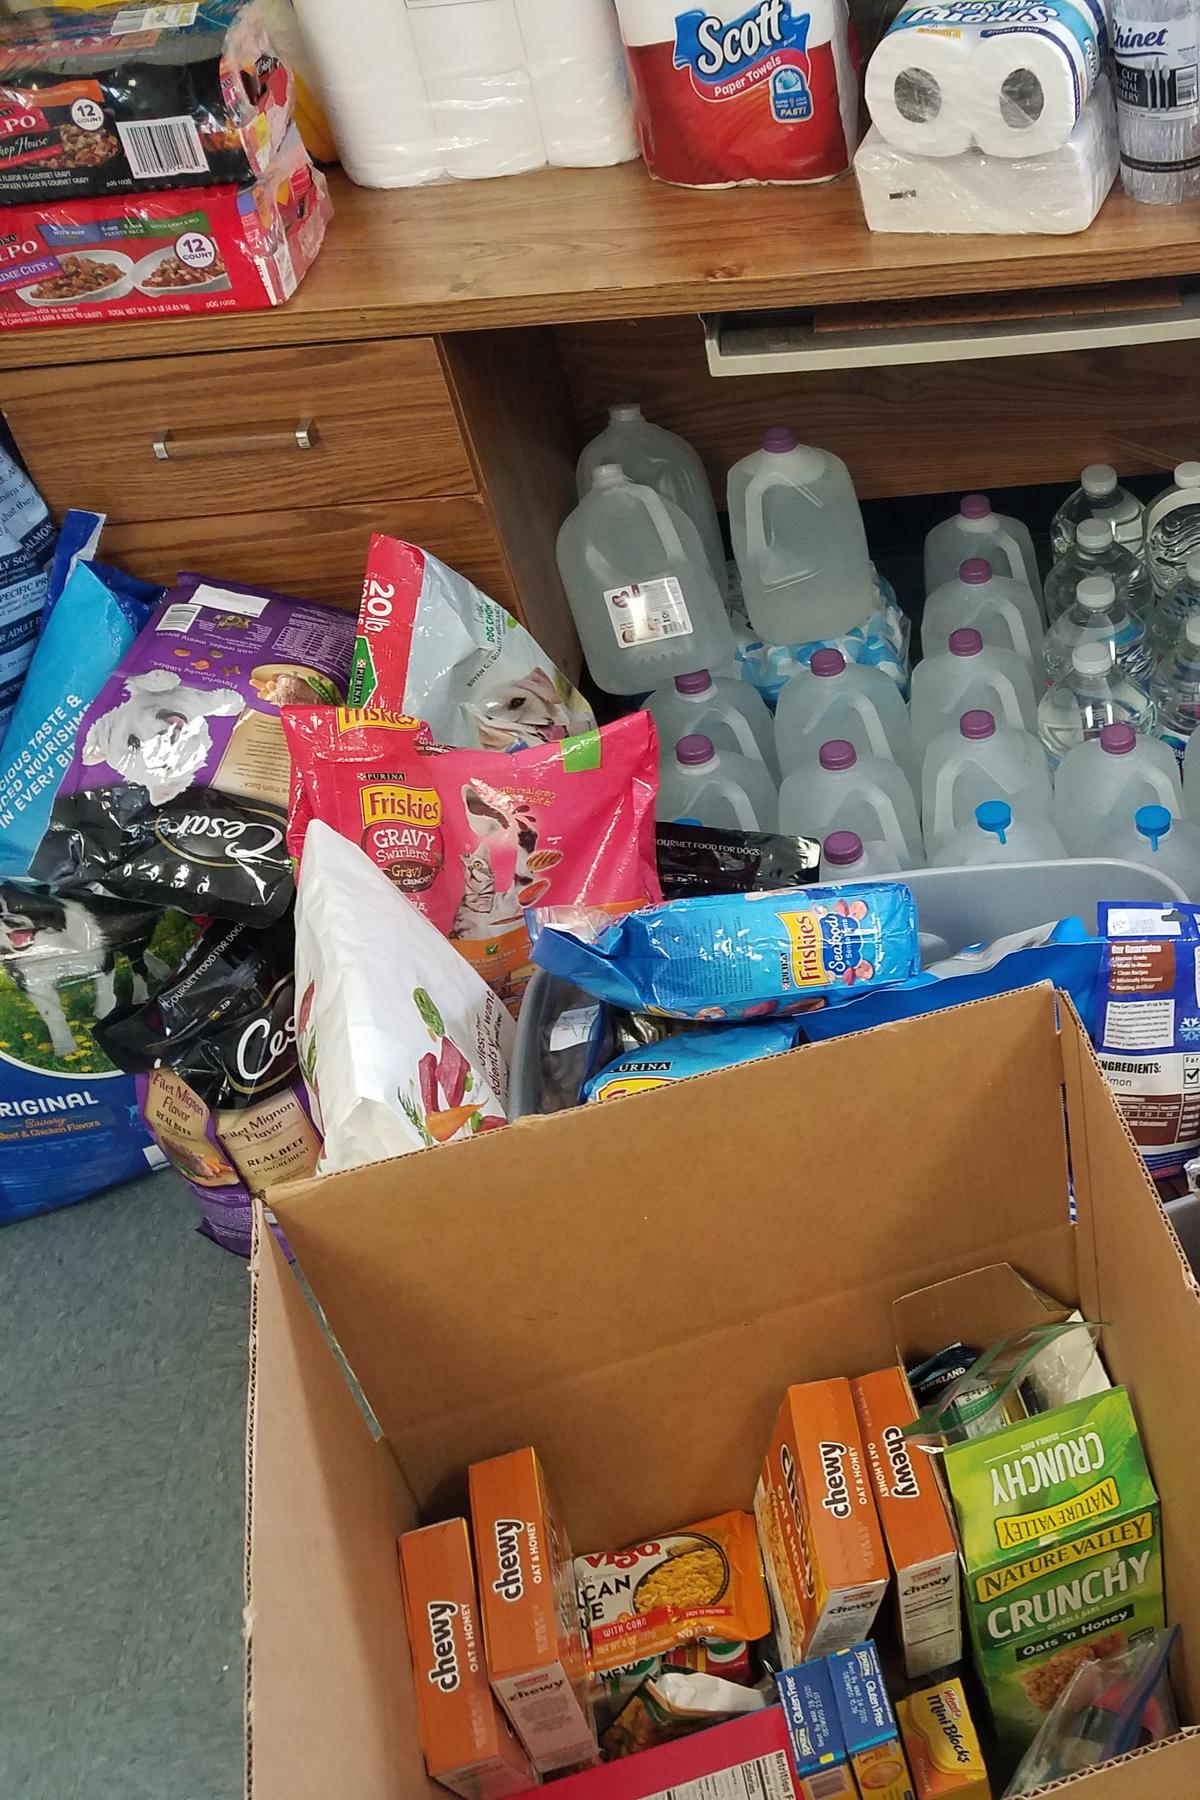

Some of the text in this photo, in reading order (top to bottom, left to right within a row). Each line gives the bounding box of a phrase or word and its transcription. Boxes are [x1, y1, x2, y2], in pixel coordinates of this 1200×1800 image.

[698, 0, 783, 73] Scott
[714, 55, 782, 97] Paper Towels
[1121, 68, 1139, 79] CUT
[0, 115, 36, 132] PO
[77, 104, 96, 117] 12
[77, 116, 102, 124] COUNT
[780, 107, 807, 117] FAST!
[15, 136, 48, 152] House
[0, 240, 38, 262] LPO
[182, 251, 213, 261] COUNT
[184, 239, 205, 252] 12
[20, 263, 48, 276] CUTS
[206, 299, 236, 309] DOG FOOD
[24, 521, 54, 552] ALMON
[0, 583, 33, 601] PECIFIC
[7, 618, 35, 639] ADULT
[485, 603, 496, 643] DOG CHOW
[354, 668, 366, 704] PURINA
[466, 668, 486, 688] BRYAN
[0, 694, 83, 792] CIOUS TASTE &
[24, 701, 93, 780] NOURISHM
[367, 772, 405, 781] PURINA
[0, 809, 15, 829] IN
[14, 765, 55, 812] EVERY
[369, 790, 439, 820] Friskies
[170, 813, 285, 860] Cesar
[373, 829, 436, 851] GRAVY
[693, 842, 717, 851] FOOD
[718, 844, 736, 853] FOR
[737, 847, 761, 857] DOGS
[391, 864, 423, 878] Gravy
[796, 915, 821, 981] Friskies
[824, 913, 846, 972] Seafood
[167, 922, 247, 1008] GOURMET FOOD FOR DOGS
[236, 1016, 296, 1080] Ces
[619, 1063, 668, 1073] URINA
[1100, 1059, 1162, 1075] NGREDIENTS:
[0, 1090, 99, 1117] RIGINAL
[152, 1073, 204, 1117] Filet Mignon
[162, 1096, 191, 1122] Flavor
[220, 1127, 249, 1141] Filet
[249, 1100, 296, 1132] Mignon
[30, 1120, 101, 1137] Chicken Flavors
[155, 1110, 192, 1137] REAL BEEF
[245, 1119, 284, 1142] Flavor
[247, 1153, 276, 1168] REAL
[278, 1136, 305, 1156] BEEF
[264, 1147, 310, 1173] INGREDIENT
[919, 1366, 966, 1392] KIRKLAND
[848, 1446, 863, 1479] HONEY
[867, 1442, 890, 1499] OAT HONEY
[882, 1425, 920, 1500] chewy
[990, 1432, 1105, 1506] CRUNCHY
[819, 1441, 853, 1519] chewy
[856, 1486, 868, 1505] OAT
[1003, 1482, 1114, 1546] NATURE VALLEY
[526, 1520, 542, 1555] HONEY
[492, 1519, 524, 1603] chewy
[983, 1549, 1069, 1597] NATURE
[1072, 1516, 1147, 1556] VALLEY
[528, 1562, 543, 1585] OAT
[902, 1575, 952, 1597] chewy
[828, 1598, 878, 1616] chewy
[987, 1550, 1150, 1640] CRUNCHY
[460, 1602, 475, 1640] HONEY
[603, 1617, 647, 1638] WITH CORN
[1046, 1606, 1100, 1631] GRANOLA BARS
[676, 1629, 694, 1640] NO
[1022, 1610, 1129, 1656] Oats Honey
[428, 1600, 460, 1694] chewy
[465, 1651, 479, 1674] OAT
[509, 1680, 563, 1701] chewy
[865, 1680, 885, 1727] Gluten Free
[791, 1698, 804, 1724] Gluten
[942, 1723, 971, 1764] Blocks
[776, 1752, 790, 1792] Nutrition
